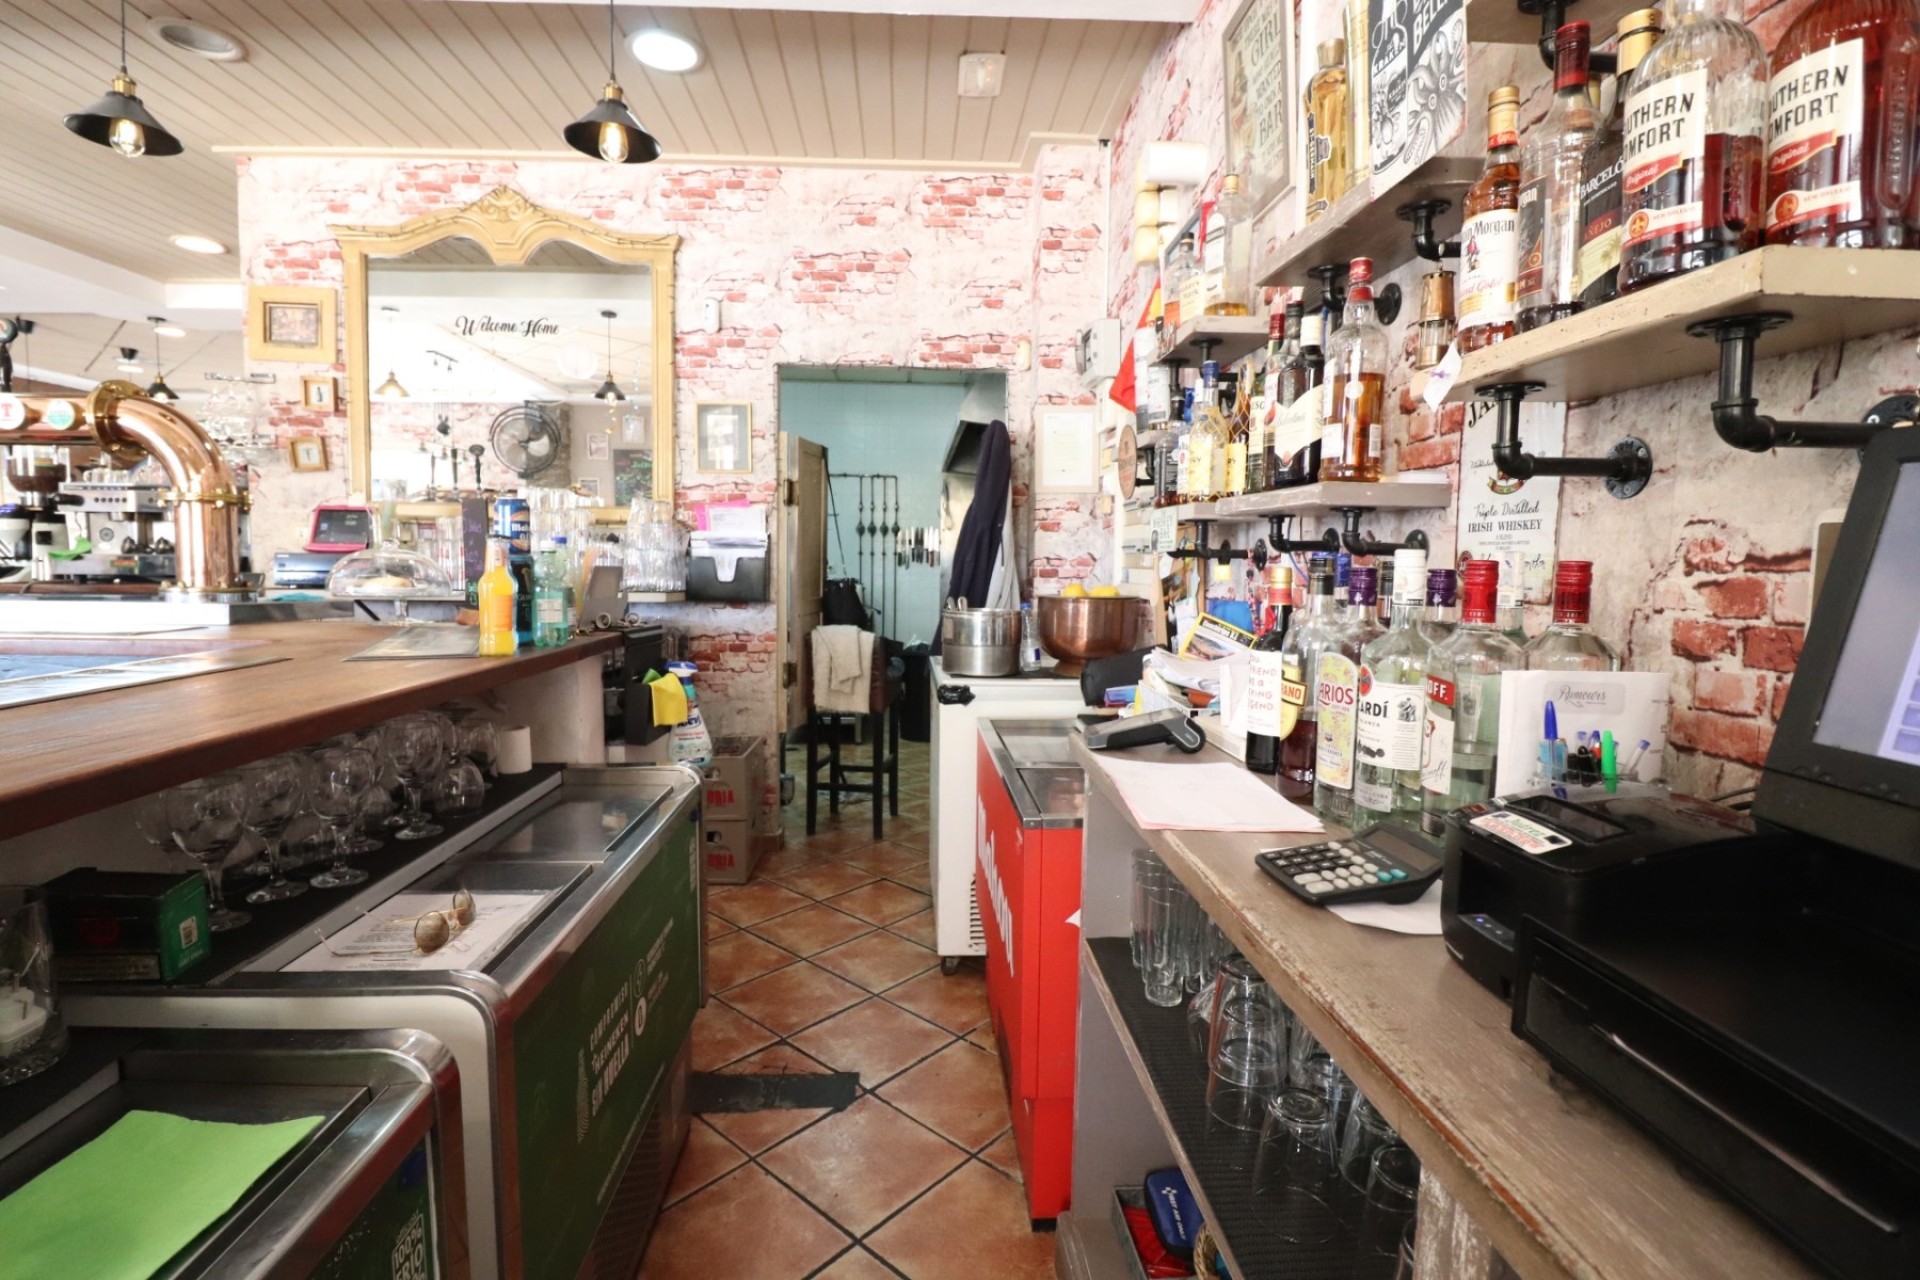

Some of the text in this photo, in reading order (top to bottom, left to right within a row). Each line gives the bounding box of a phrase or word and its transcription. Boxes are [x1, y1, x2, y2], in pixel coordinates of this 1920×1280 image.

[1251, 13, 1281, 67] GIRL
[1259, 99, 1283, 147] BAR
[1768, 92, 1839, 146] OMFORT
[1623, 117, 1686, 164] OMFORT
[1579, 154, 1624, 199] BARCELÓ
[1474, 219, 1516, 237] Morgan
[455, 315, 559, 338] Welcome Home
[1474, 498, 1540, 520] Triple Distilled
[1468, 518, 1543, 533] IRISH WHISKEY
[1281, 684, 1303, 700] ANO
[1319, 682, 1354, 706] ARIOS
[1558, 684, 1606, 708] Rumours
[1358, 700, 1390, 719] ARDÍ
[394, 1220, 423, 1269] 100%
